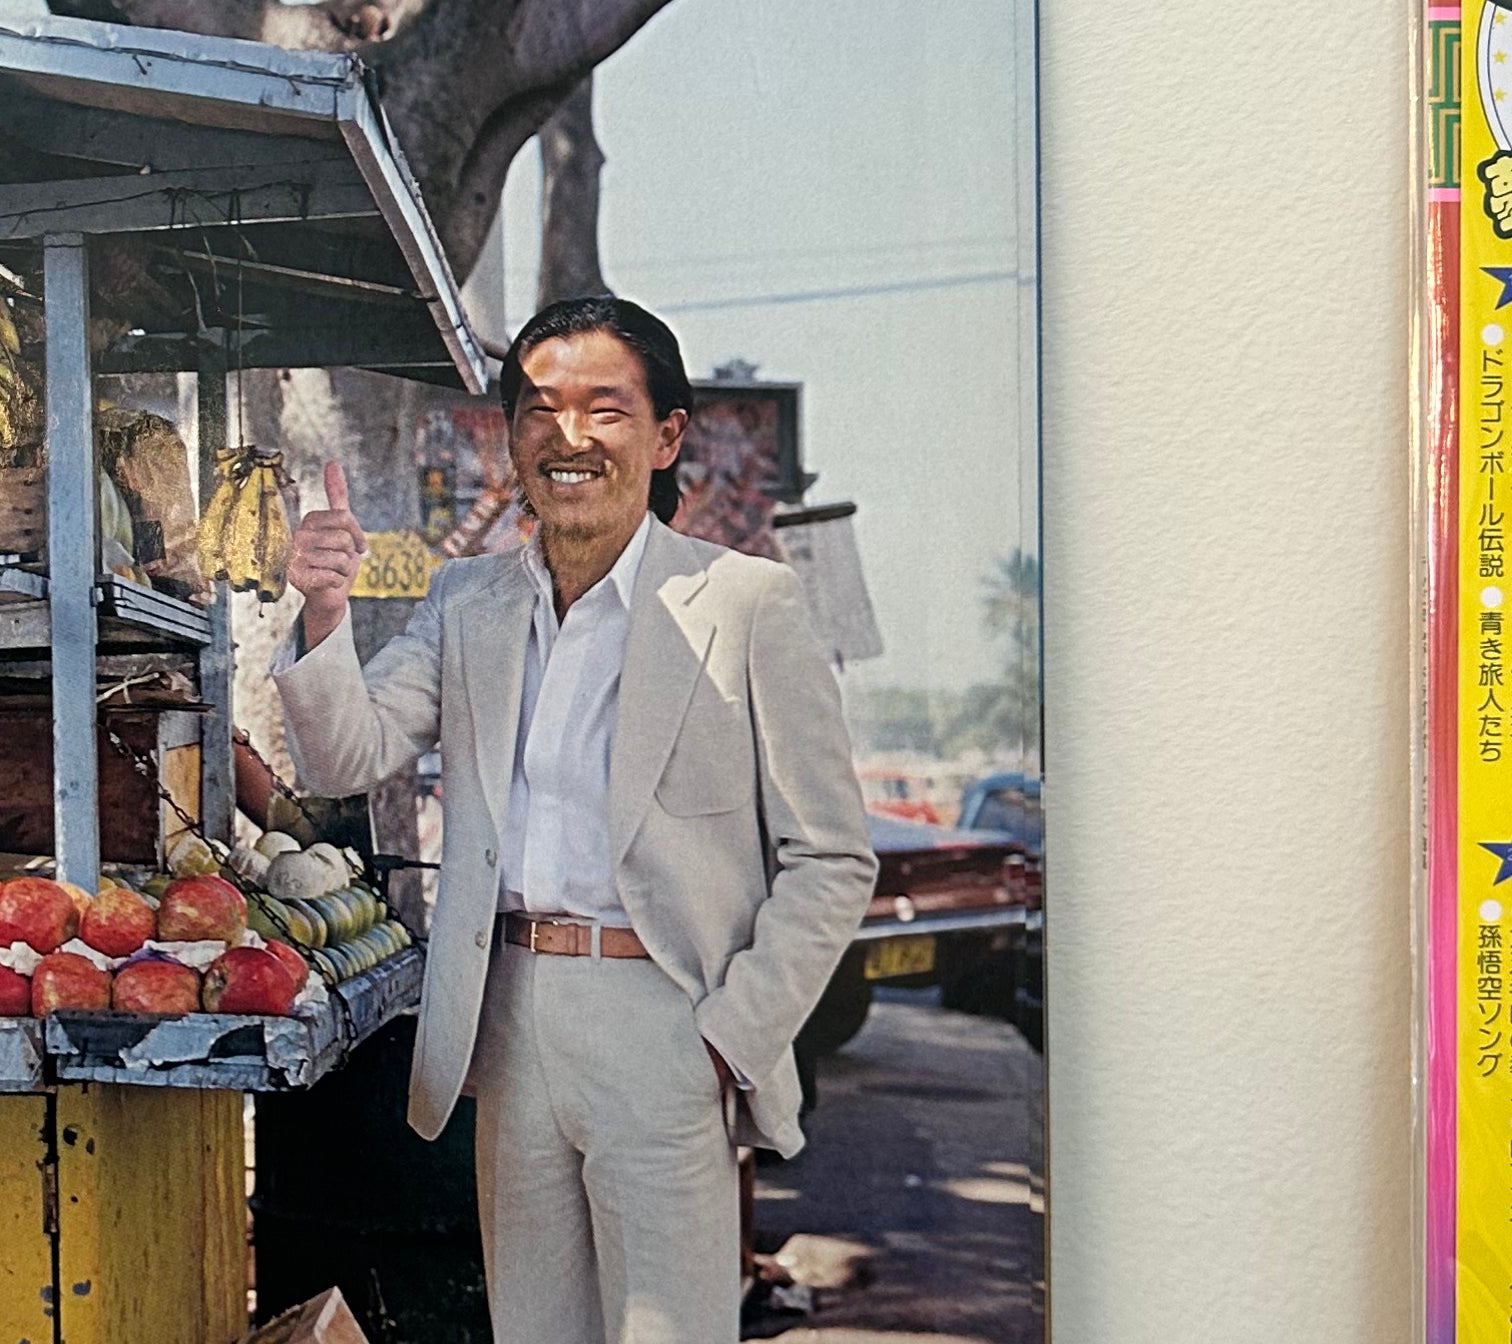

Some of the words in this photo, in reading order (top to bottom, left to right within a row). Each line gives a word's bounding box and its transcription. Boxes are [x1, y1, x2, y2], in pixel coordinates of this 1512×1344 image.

[1478, 348, 1505, 577] ドラゴンボール伝説
[1478, 612, 1505, 763] 青き旅人たち
[1477, 925, 1504, 1078] 孫悟空ソング
